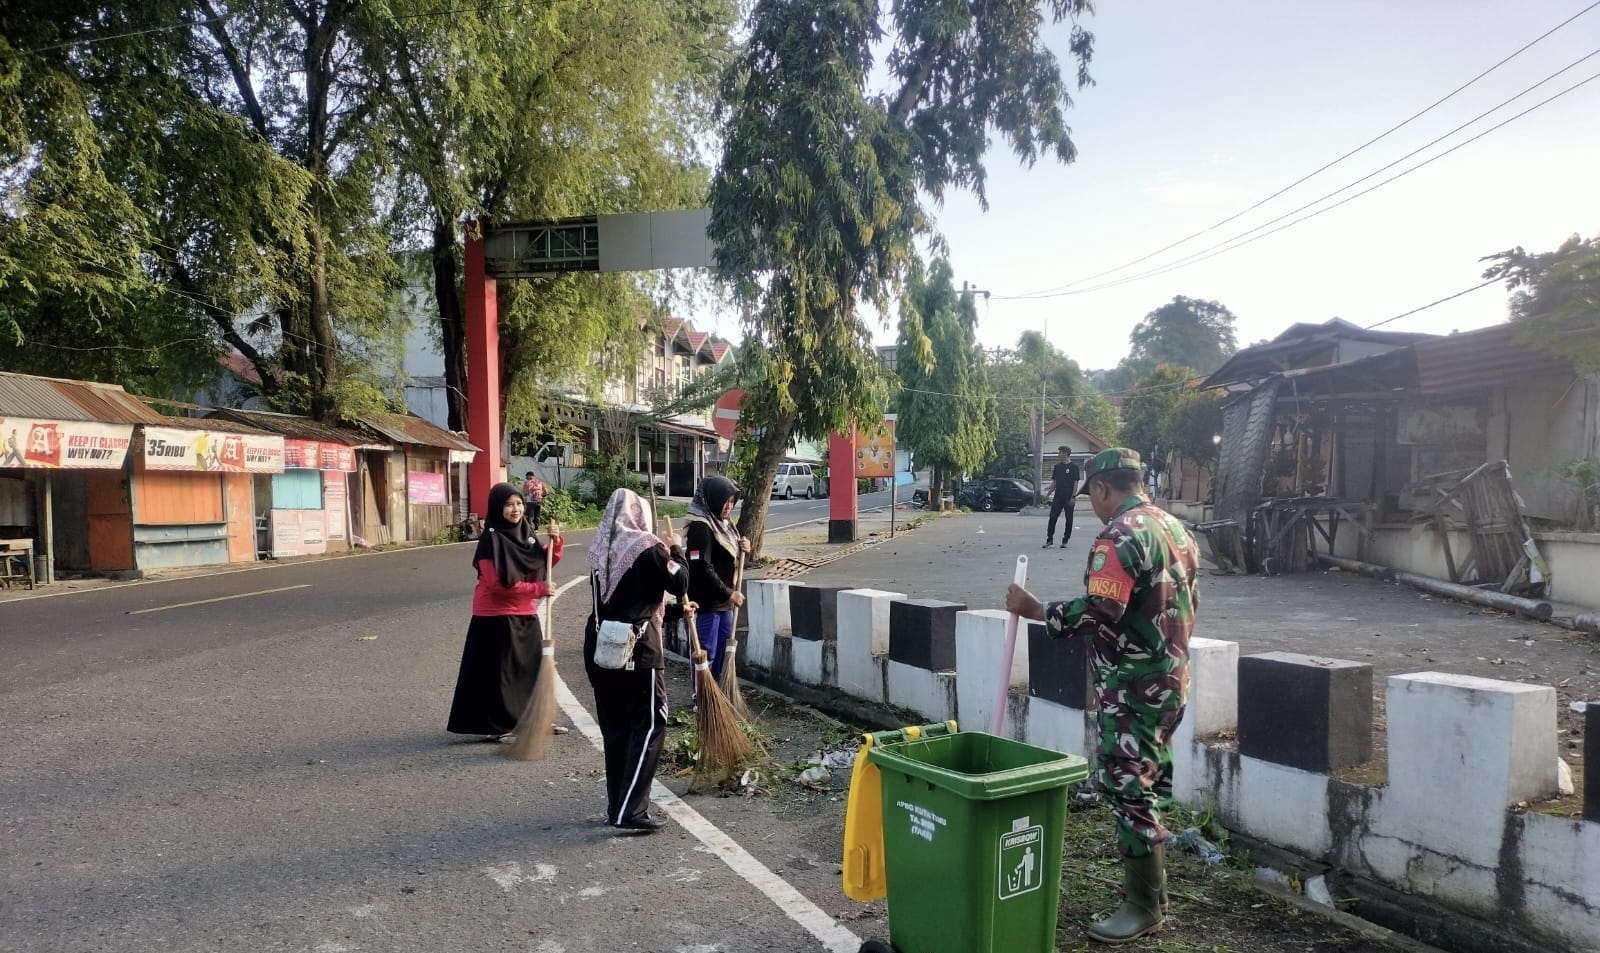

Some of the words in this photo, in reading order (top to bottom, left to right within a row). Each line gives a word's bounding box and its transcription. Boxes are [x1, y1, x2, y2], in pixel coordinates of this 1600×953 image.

[68, 434, 89, 447] KEEP
[90, 436, 98, 448] IT
[99, 436, 129, 450] CLASSIC
[67, 447, 90, 459] WHY
[90, 448, 113, 460] NOT?
[1005, 831, 1038, 847] KRISBOW
